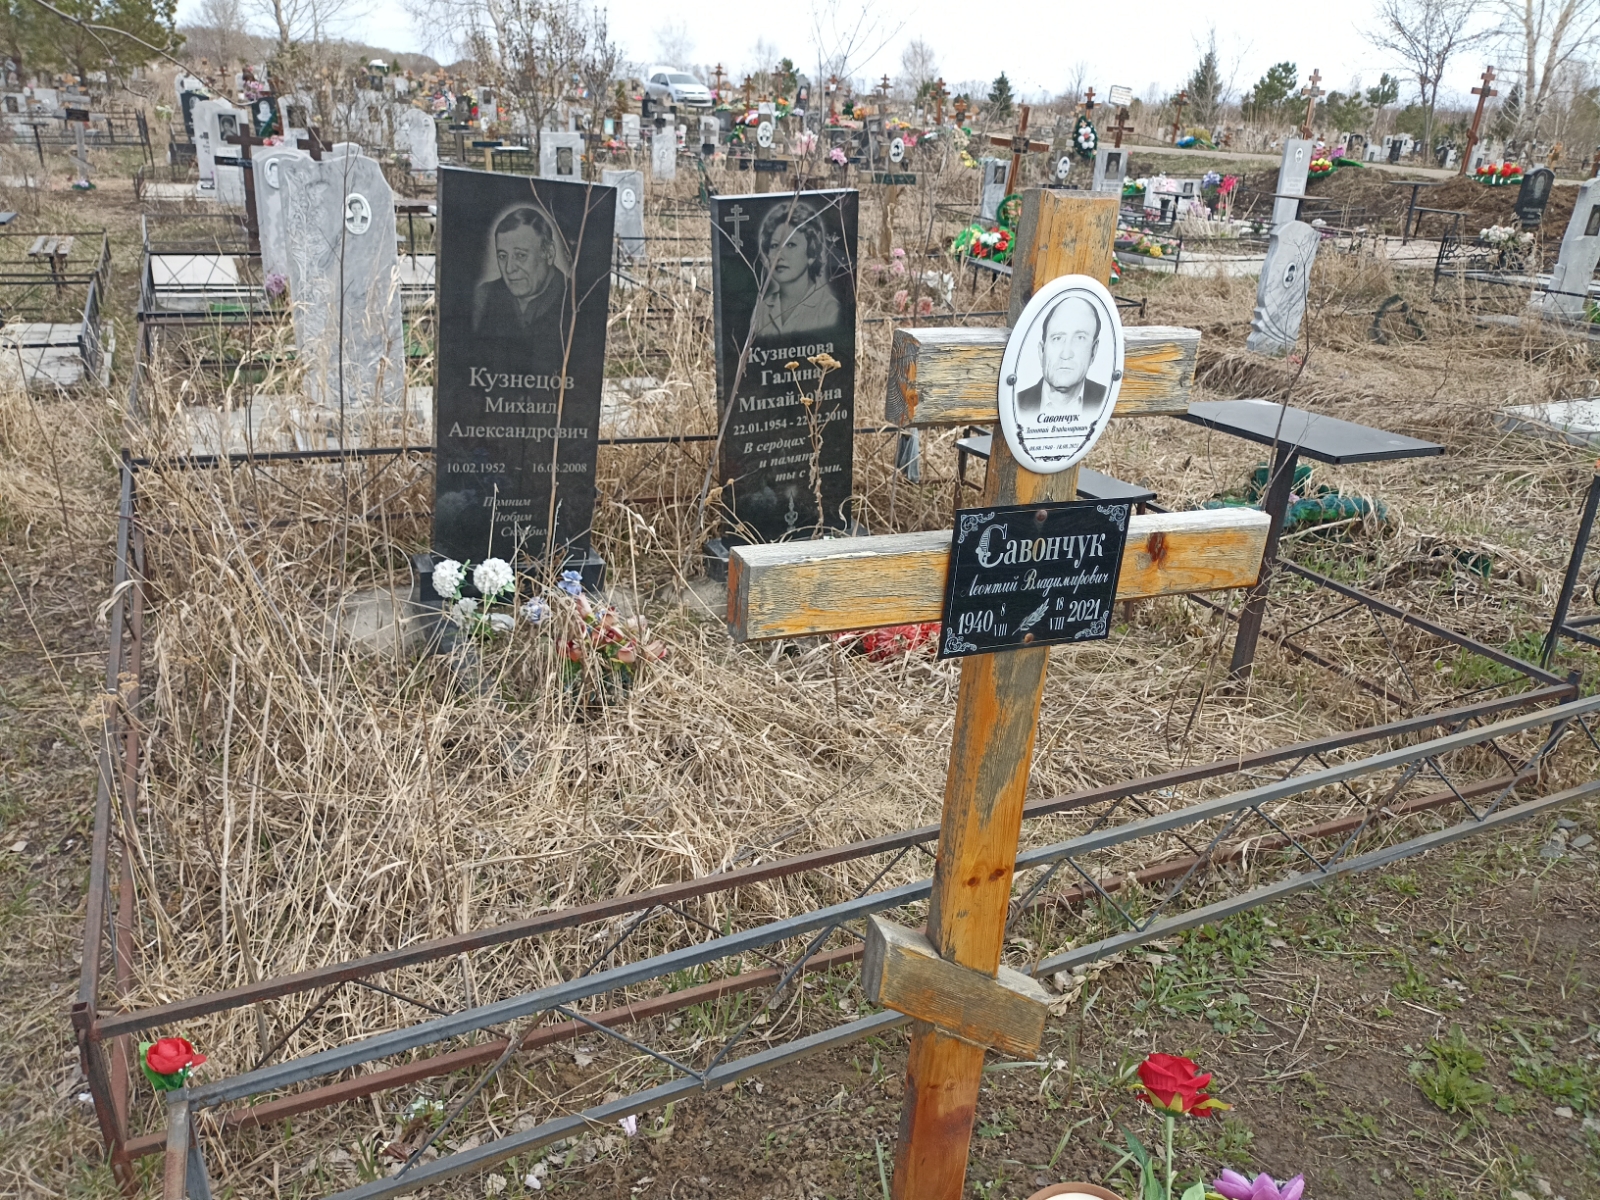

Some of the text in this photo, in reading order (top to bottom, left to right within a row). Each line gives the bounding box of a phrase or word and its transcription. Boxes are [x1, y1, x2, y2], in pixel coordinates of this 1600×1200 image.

[469, 367, 575, 392] Кузнецов
[761, 368, 820, 386] Галина
[485, 397, 557, 414] Михаил
[733, 418, 787, 435] 22.01.1954
[1036, 413, 1080, 424] Савончук
[448, 422, 588, 442] Александрович
[743, 435, 805, 454] В сердцах
[447, 463, 506, 473] 10.02.1952
[759, 459, 767, 468] и
[775, 471, 796, 482] ты
[799, 469, 806, 478] с
[975, 523, 1106, 568] Савончук
[960, 565, 1109, 597] Леонтий Владимирович
[1000, 603, 1006, 616] 8
[1056, 597, 1065, 611] 18
[1067, 598, 1101, 622] 2021
[958, 610, 994, 635] 1940
